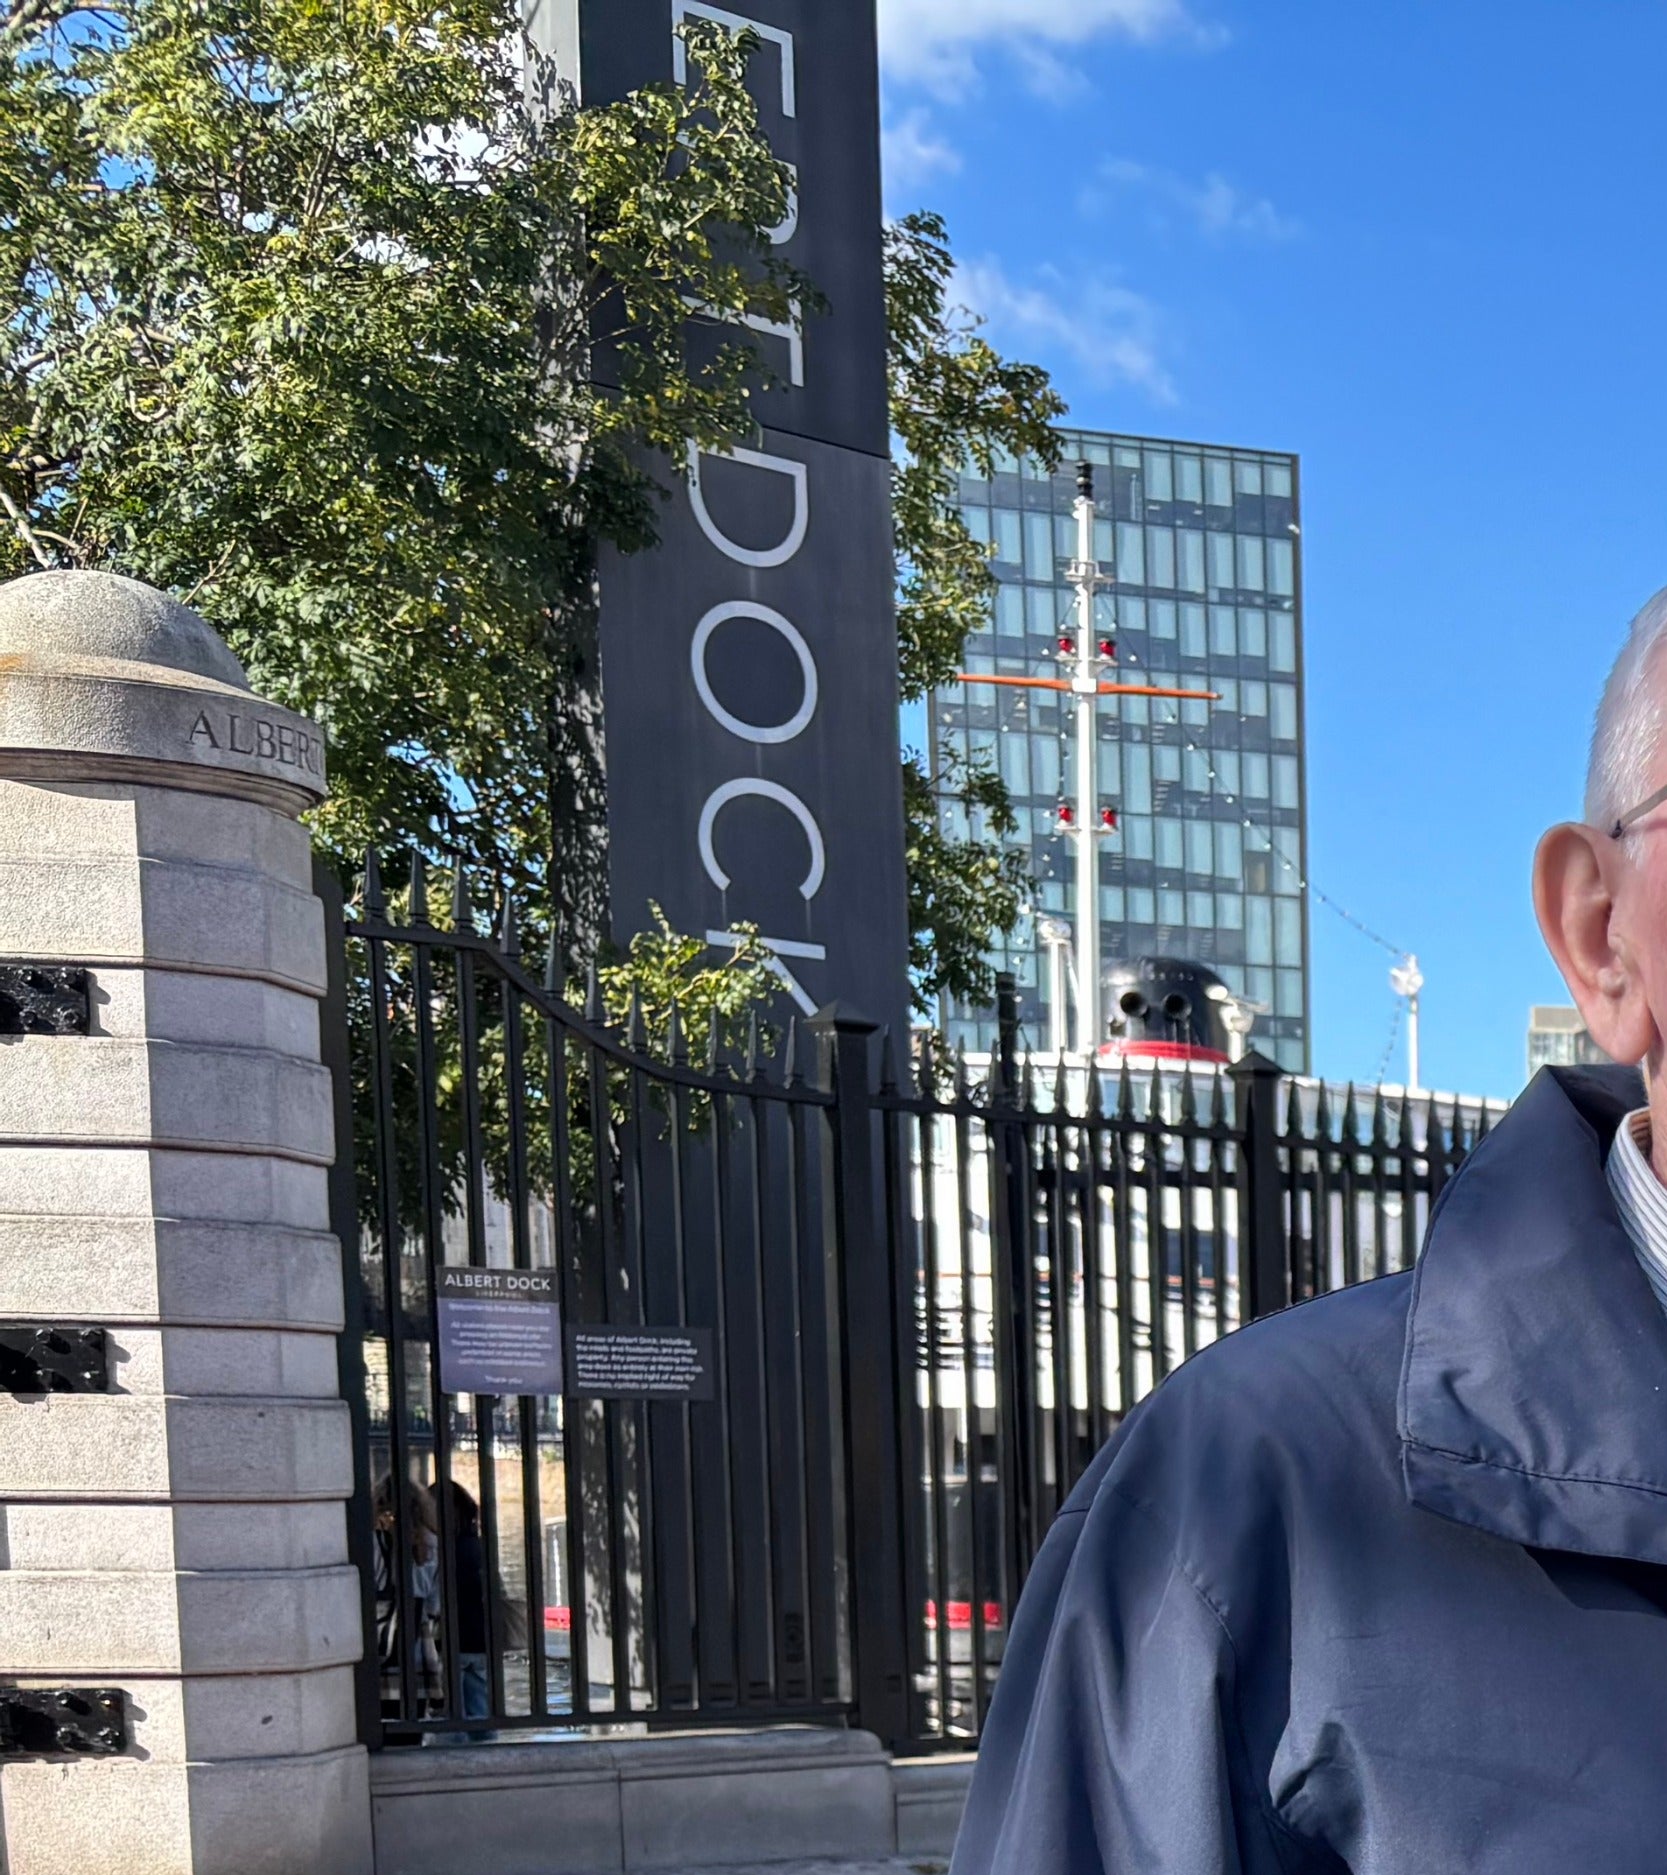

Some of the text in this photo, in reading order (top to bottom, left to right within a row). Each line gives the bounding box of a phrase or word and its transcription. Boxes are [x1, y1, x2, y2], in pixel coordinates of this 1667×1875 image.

[186, 709, 322, 776] ALBERT
[686, 438, 827, 1018] DOCK
[444, 1274, 551, 1291] ALBERT DOCK
